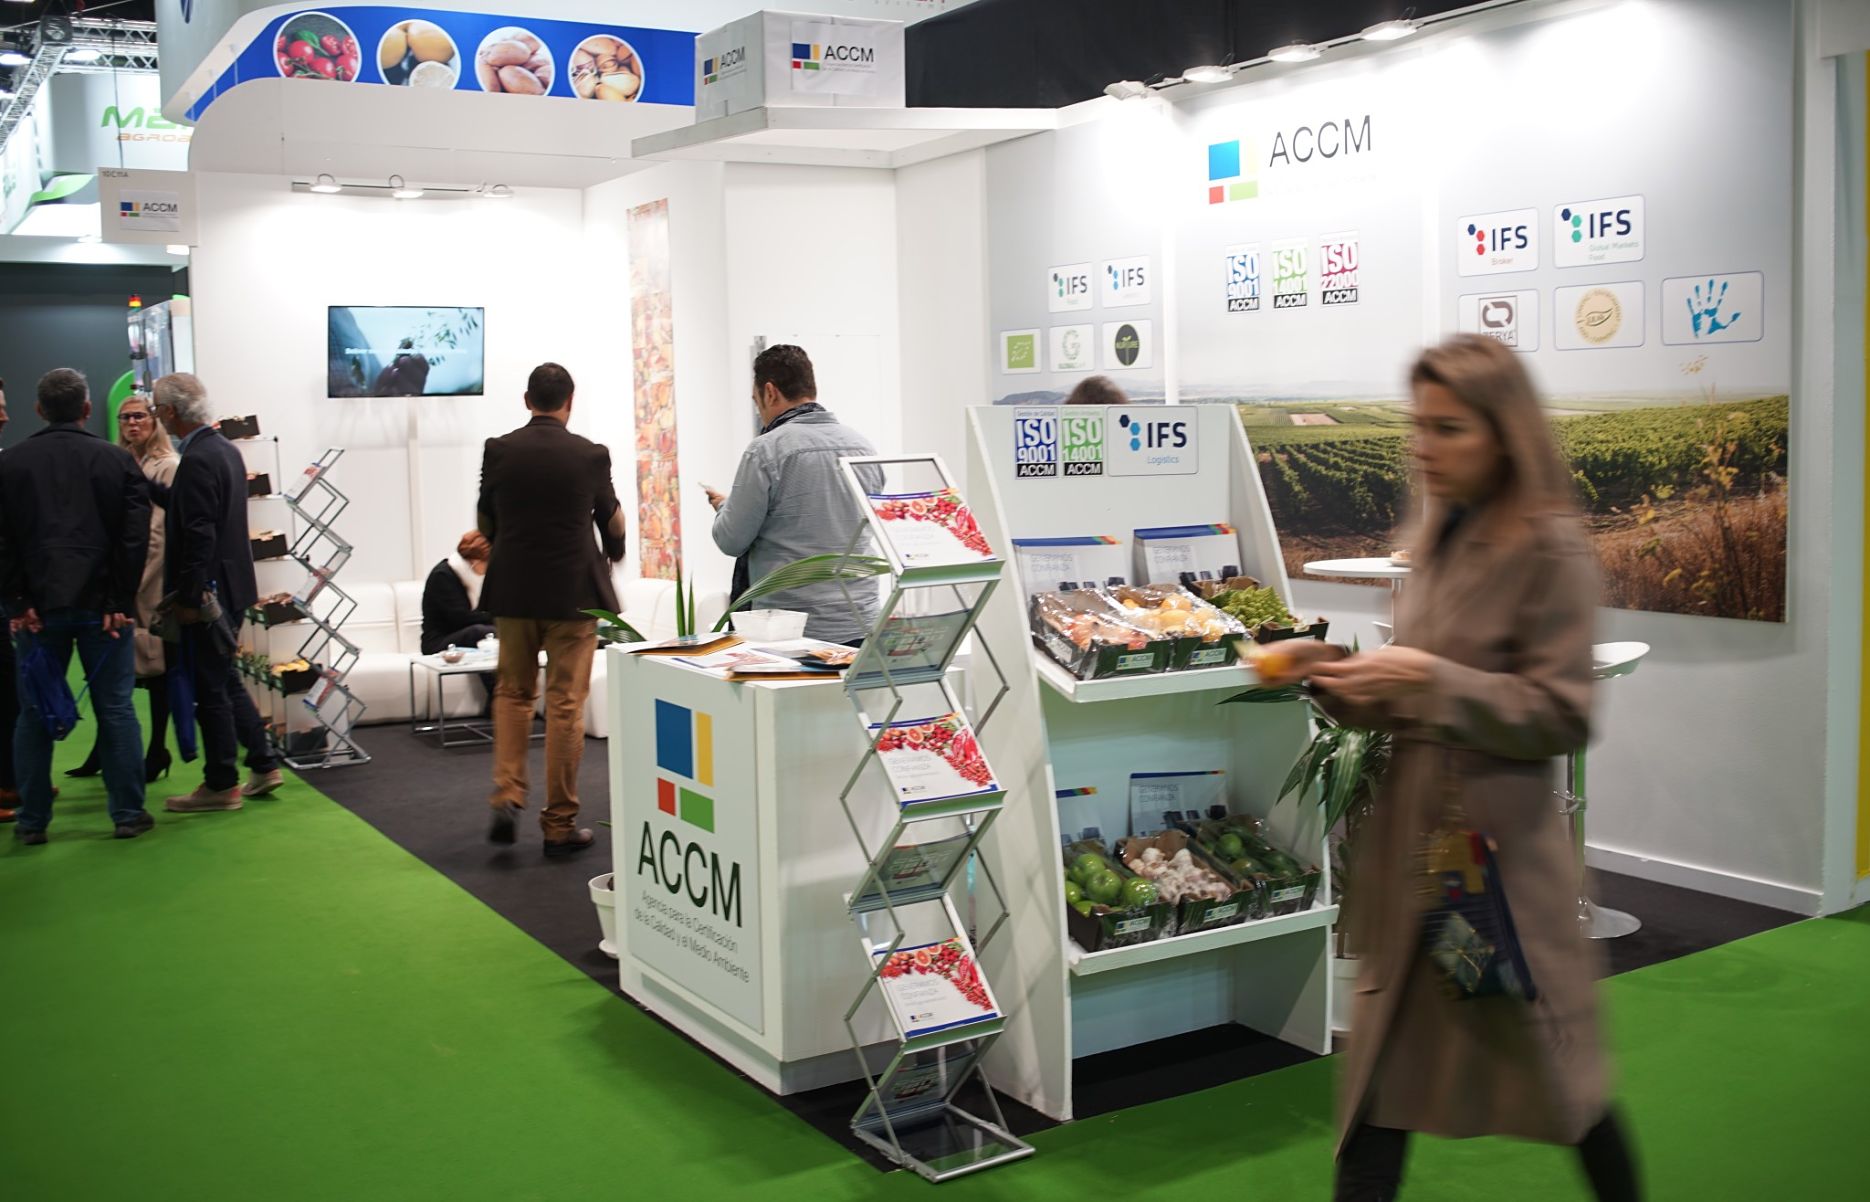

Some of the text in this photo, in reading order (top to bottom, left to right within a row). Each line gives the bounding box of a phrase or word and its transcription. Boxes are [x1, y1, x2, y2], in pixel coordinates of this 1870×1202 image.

[720, 46, 746, 68] ACCM
[824, 45, 874, 62] ACCM
[1269, 115, 1371, 167] ACCM
[143, 202, 178, 212] ACCM
[1589, 210, 1631, 238] IFS
[1492, 225, 1528, 251] IFS
[1227, 253, 1259, 283] ISO
[1273, 248, 1307, 280] ISO
[1321, 241, 1358, 275] ISO
[1066, 275, 1088, 295] IFS
[1122, 267, 1145, 287] IFS
[1321, 271, 1359, 289] 22000
[1229, 298, 1258, 311] ACCM
[1276, 294, 1306, 308] ACCM
[1324, 289, 1357, 304] ACCM
[1017, 418, 1056, 447] ISO
[1063, 418, 1102, 447] ISO
[1148, 422, 1187, 448] IFS
[1018, 444, 1056, 462] 9001
[1063, 444, 1103, 462] 14001
[1147, 456, 1180, 466] Logistics
[1020, 464, 1055, 476] ACCM
[1067, 463, 1101, 475] ACCM
[637, 820, 742, 928] ACCM
